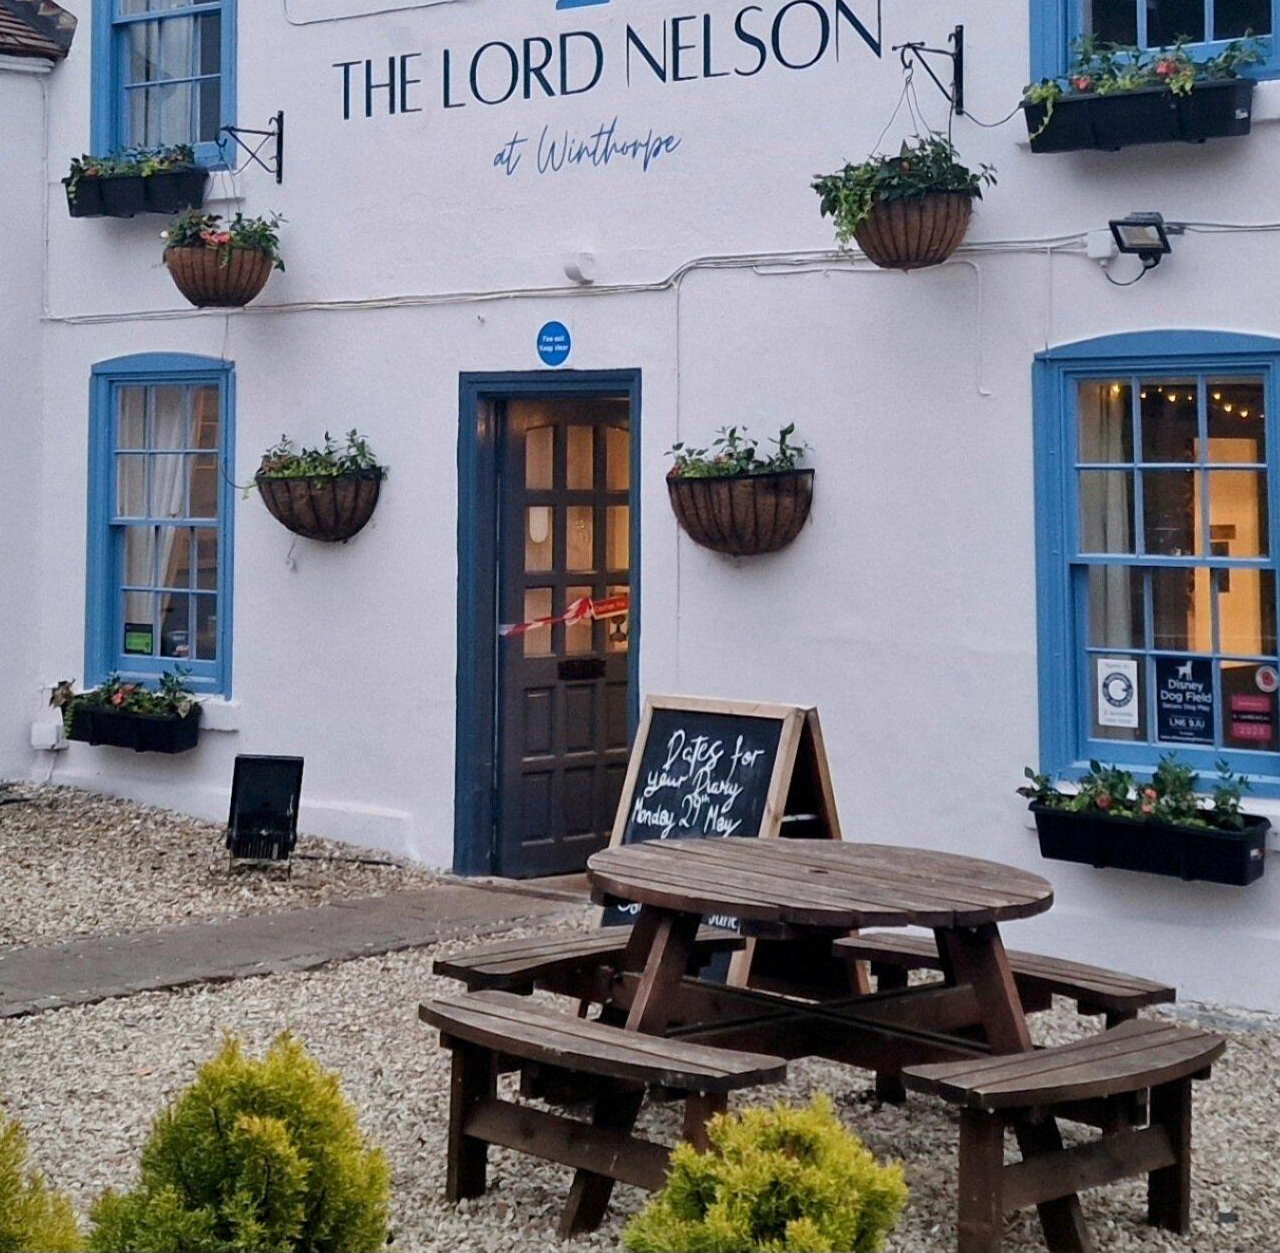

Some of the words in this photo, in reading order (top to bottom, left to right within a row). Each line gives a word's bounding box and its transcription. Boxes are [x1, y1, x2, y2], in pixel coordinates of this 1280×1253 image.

[332, 52, 422, 120] THE
[443, 30, 603, 109] LORD
[494, 131, 528, 176] at
[537, 116, 681, 174] Winthorpe
[1160, 689, 1183, 703] Dog
[1185, 691, 1212, 703] Field
[1168, 678, 1203, 692] Disney
[662, 729, 724, 776] Dates
[727, 735, 765, 784] for
[692, 766, 743, 813] Diary
[632, 797, 676, 839] Monday
[704, 804, 742, 838] May
